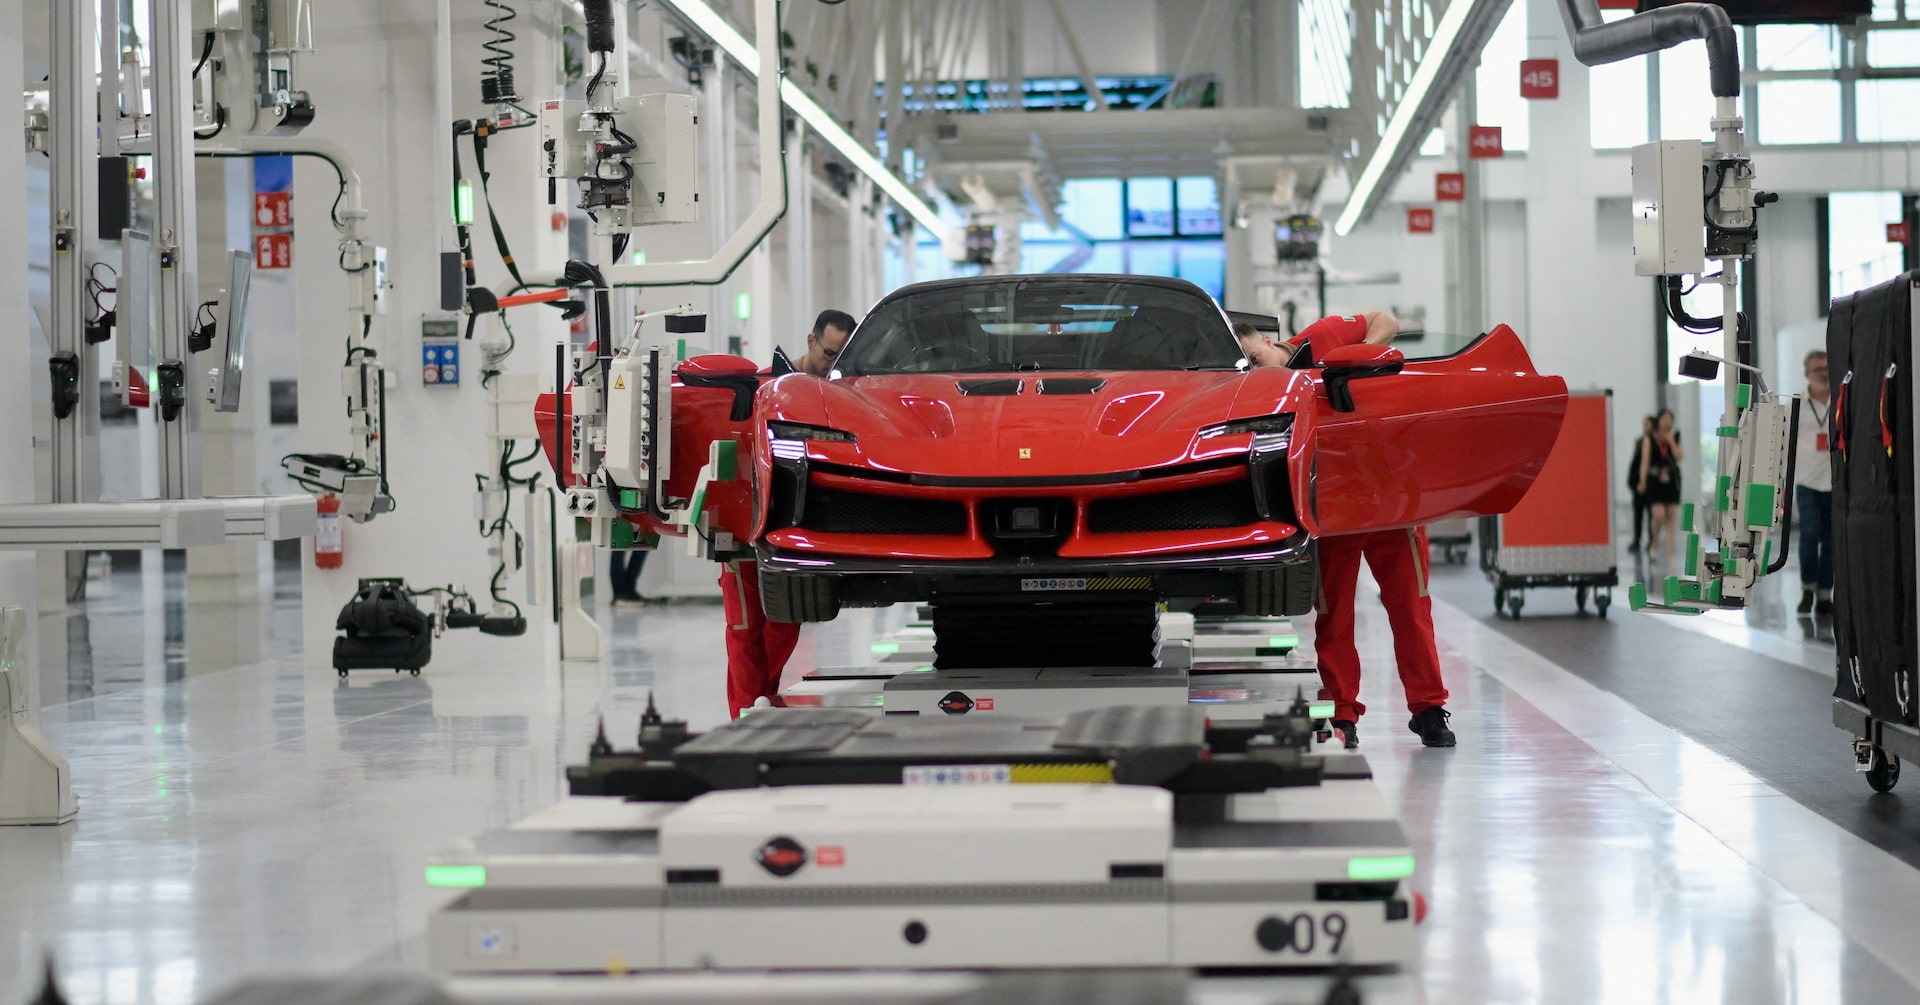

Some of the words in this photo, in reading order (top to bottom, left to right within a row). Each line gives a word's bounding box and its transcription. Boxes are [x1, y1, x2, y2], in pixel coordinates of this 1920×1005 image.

[1523, 70, 1554, 88] 45
[1473, 135, 1499, 150] 44
[1291, 912, 1347, 955] 09
